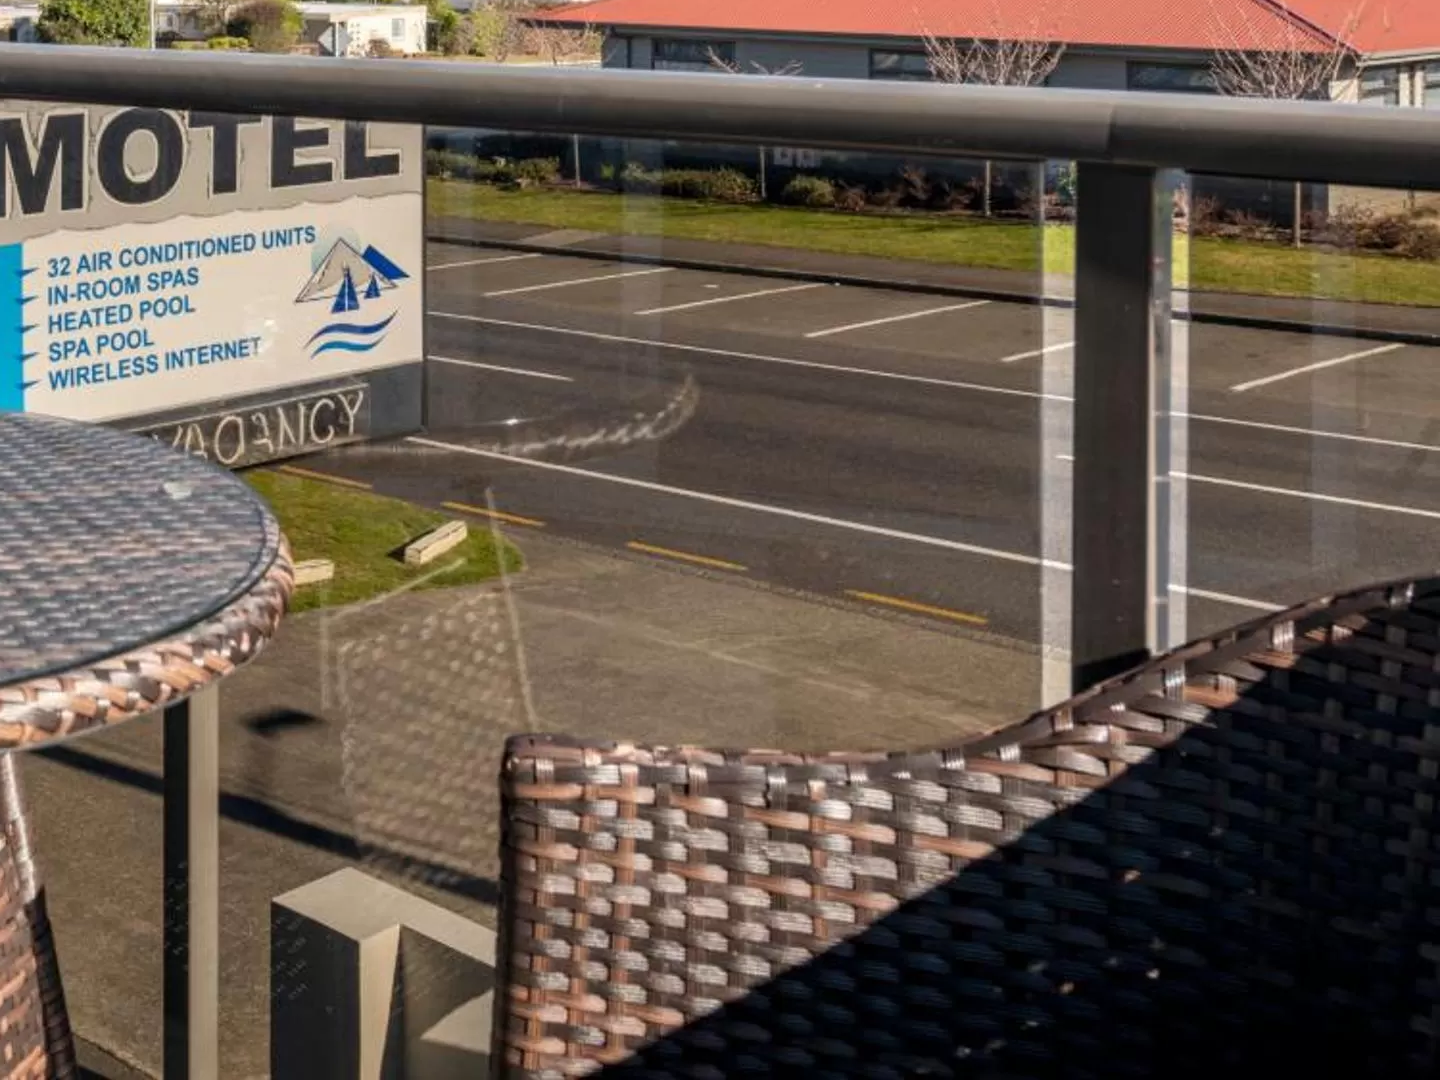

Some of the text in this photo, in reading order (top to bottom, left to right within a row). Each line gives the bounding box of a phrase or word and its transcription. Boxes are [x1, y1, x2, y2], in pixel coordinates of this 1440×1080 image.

[47, 225, 316, 278] 32 AIR CONDITIONED UNITS
[47, 267, 199, 306] IN-ROOM SPAS
[48, 294, 196, 334] HEATED POOL
[48, 328, 154, 362] SPA POOL
[48, 336, 262, 391] WIRELESS INTERNET
